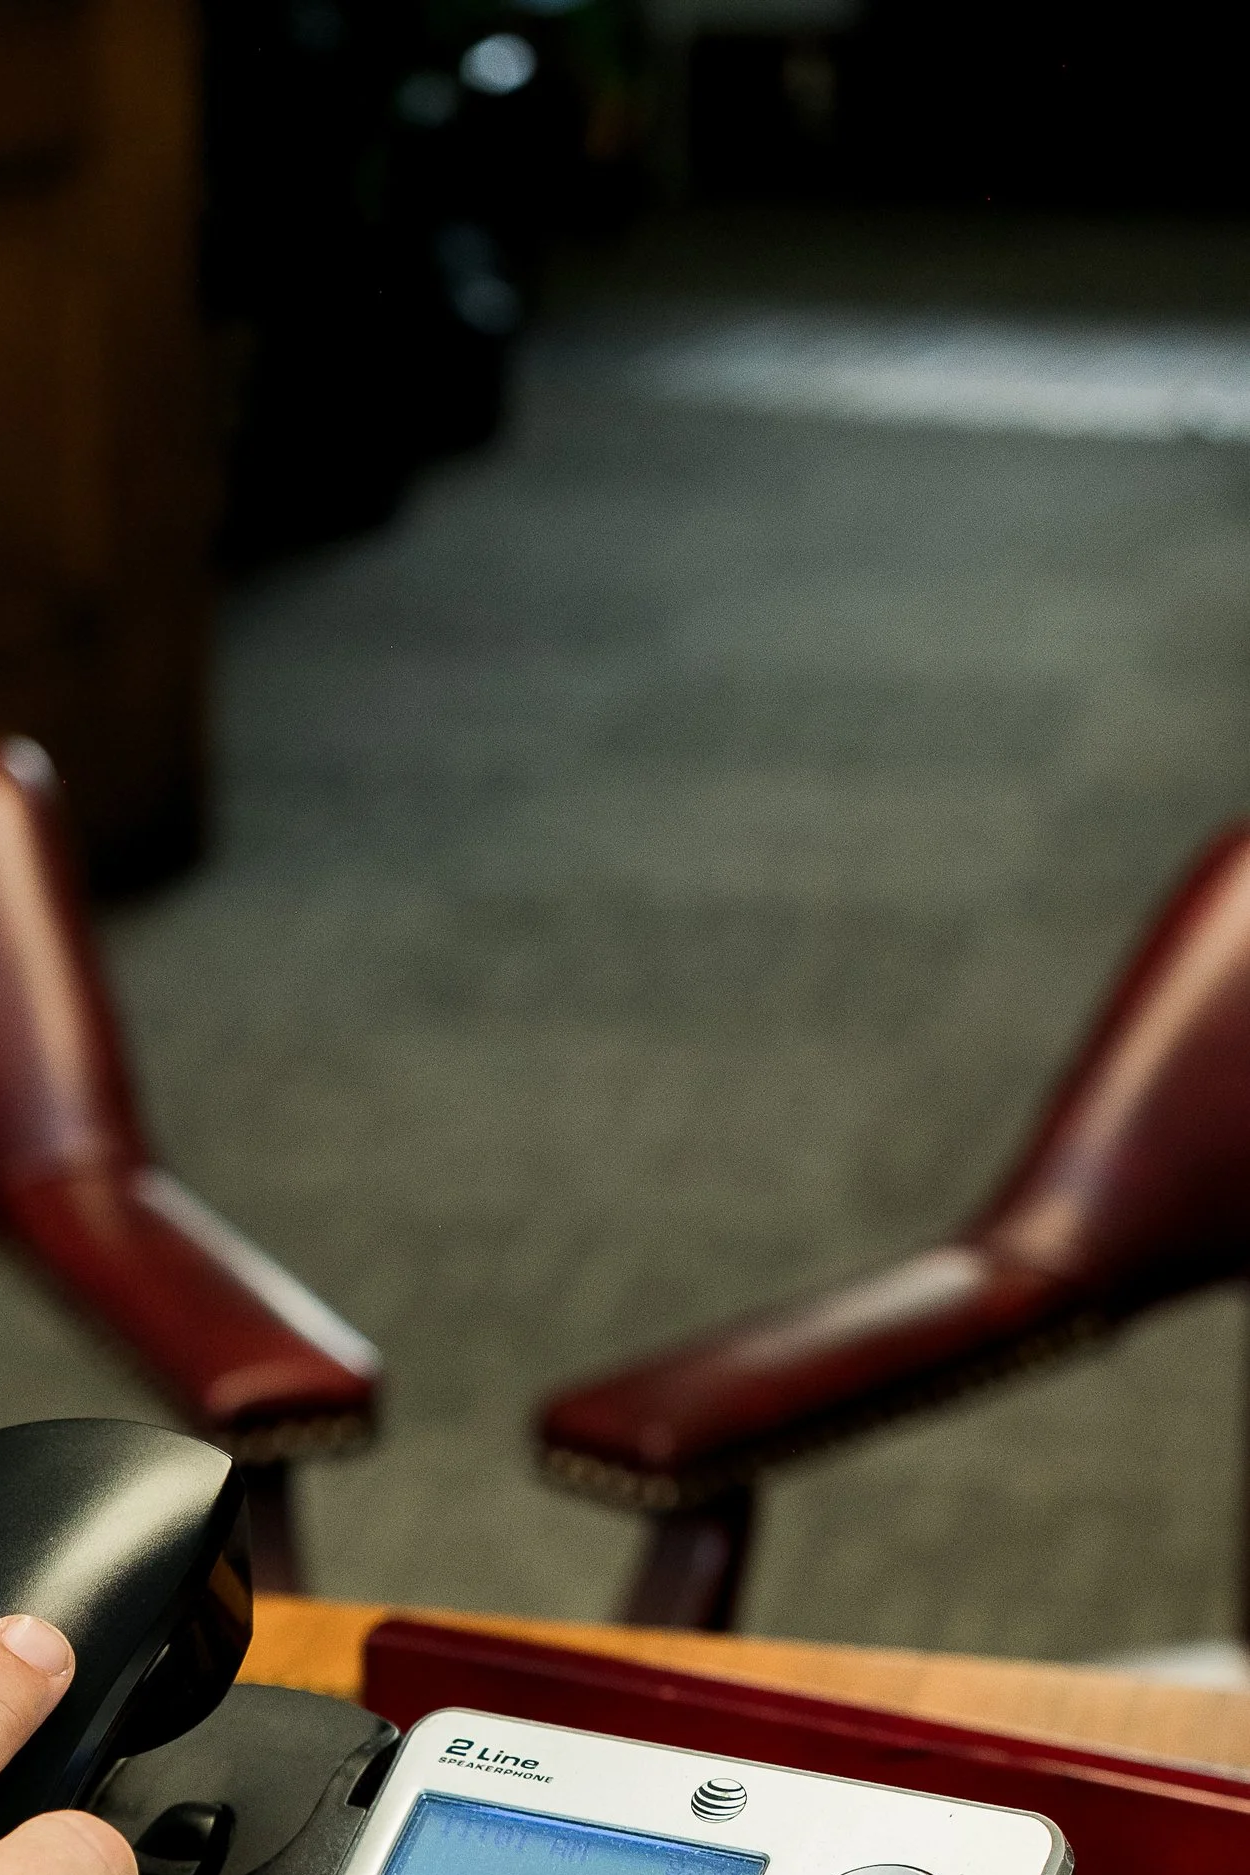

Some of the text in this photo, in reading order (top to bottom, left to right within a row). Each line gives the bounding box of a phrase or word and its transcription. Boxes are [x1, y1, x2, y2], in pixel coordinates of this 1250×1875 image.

[445, 1738, 539, 1769] 2 Line
[438, 1756, 554, 1784] SPEAKERPHONE
